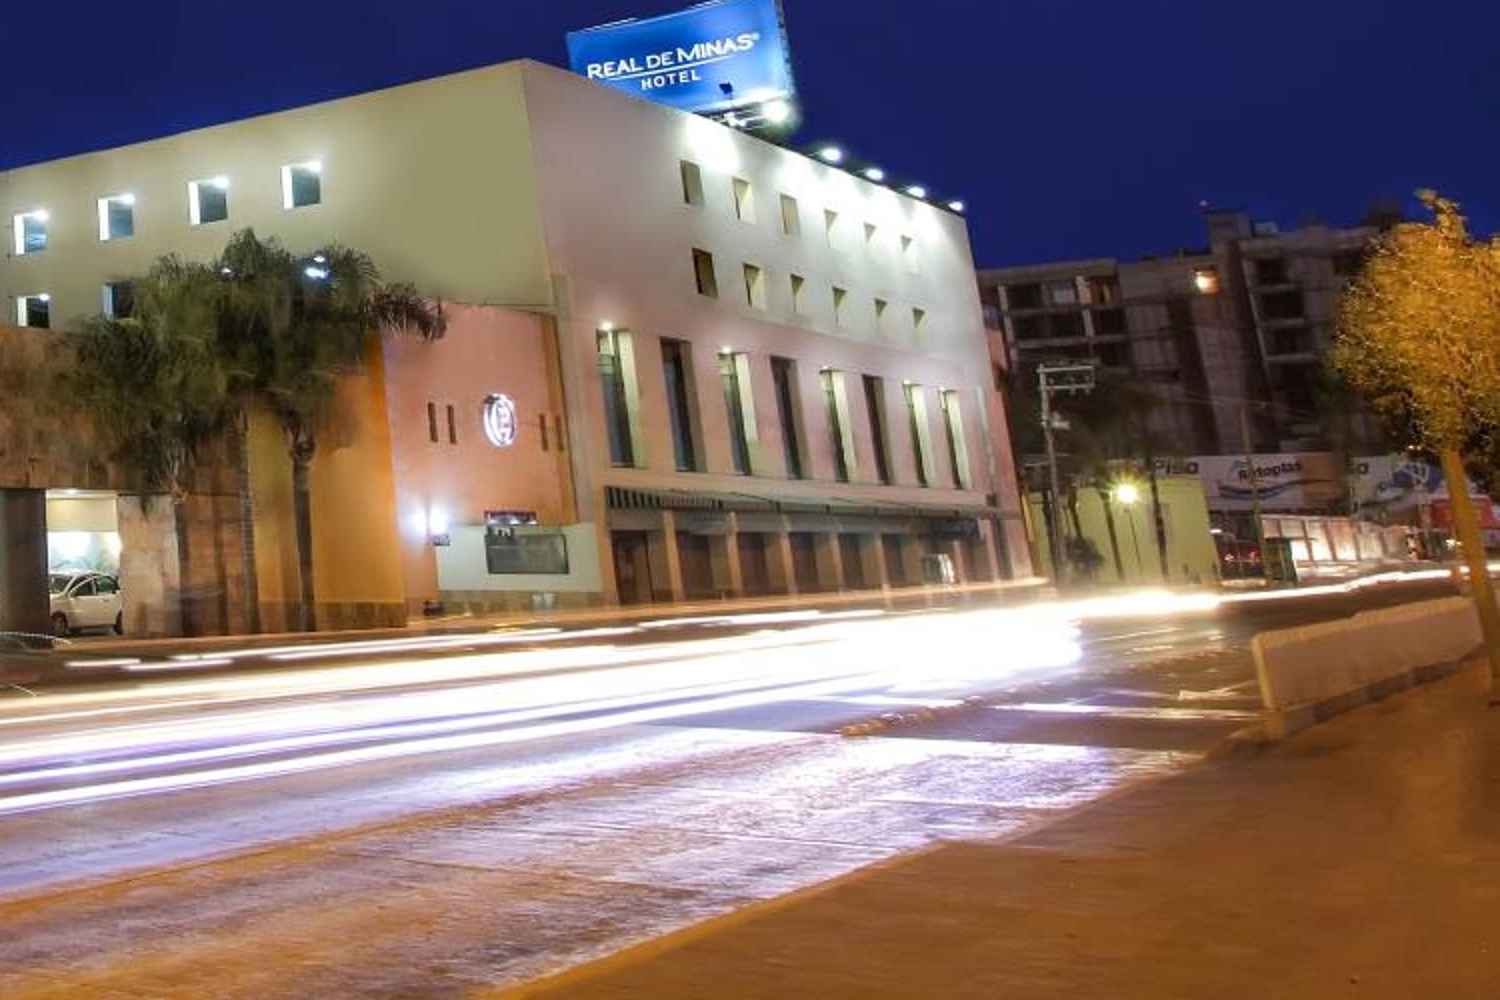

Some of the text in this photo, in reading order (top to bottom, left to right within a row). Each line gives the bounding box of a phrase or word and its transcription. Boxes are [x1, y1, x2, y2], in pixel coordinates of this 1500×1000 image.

[587, 58, 644, 80] REAL
[646, 51, 674, 70] DE
[640, 69, 701, 91] HOTEL
